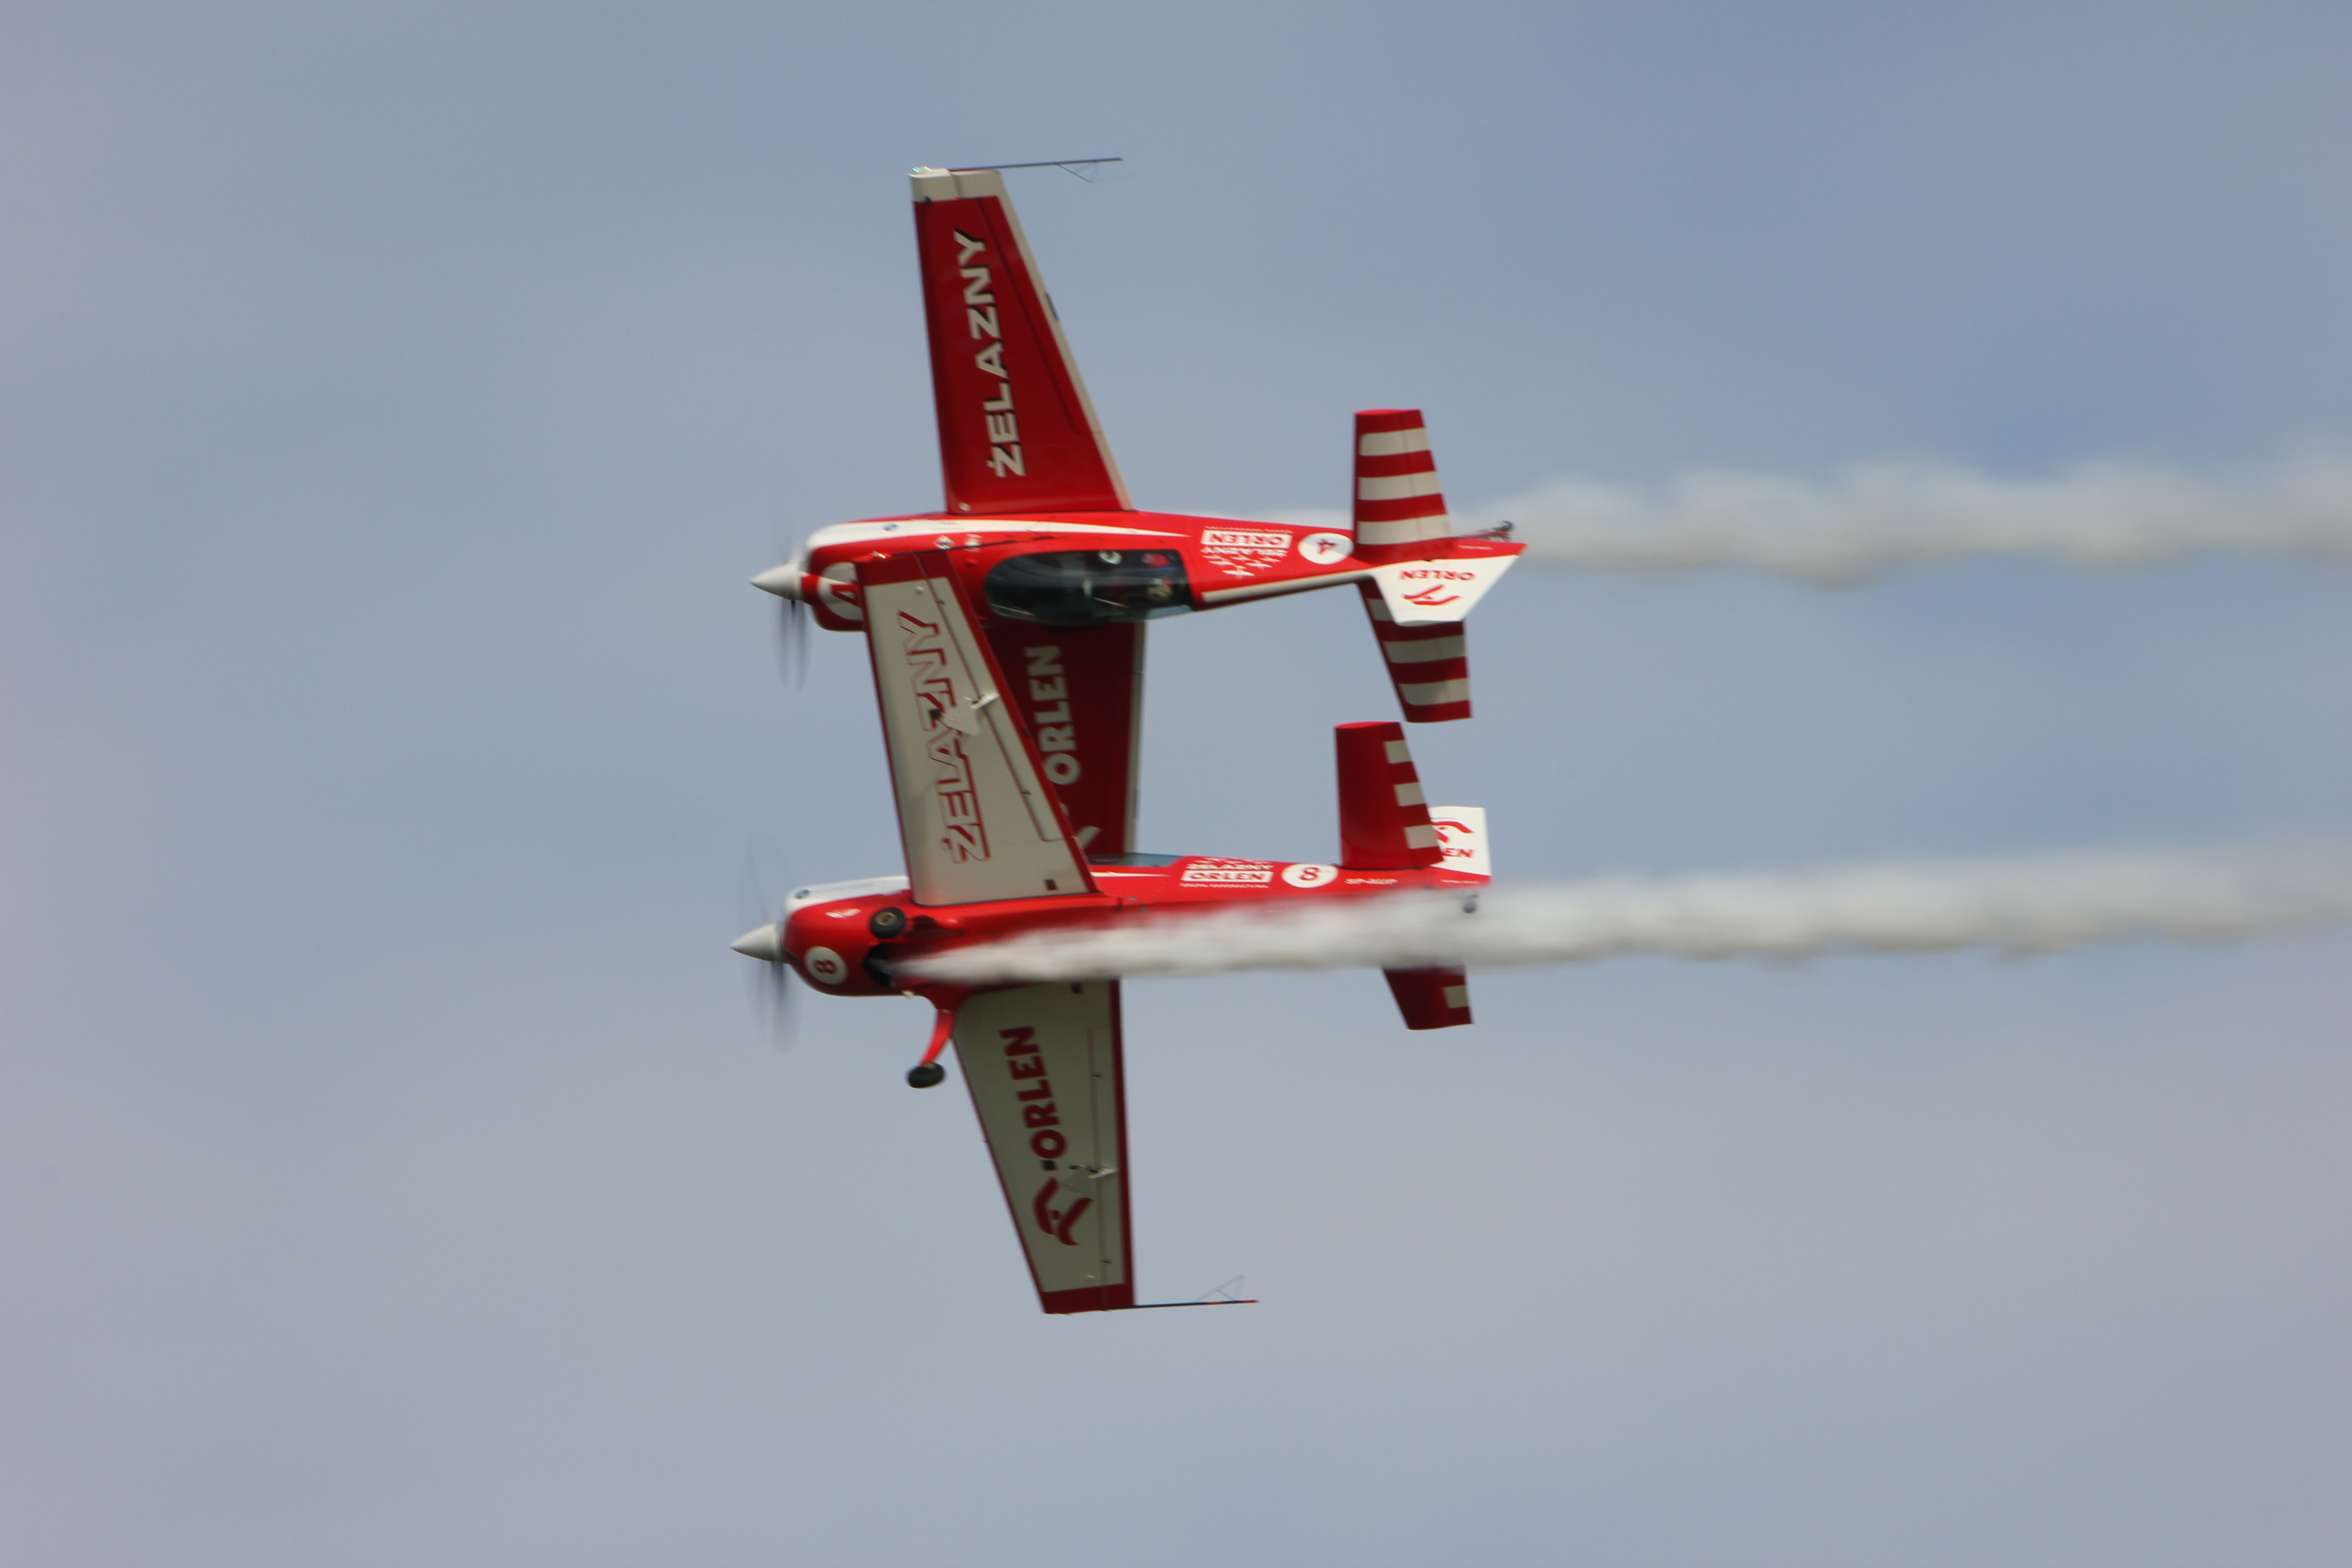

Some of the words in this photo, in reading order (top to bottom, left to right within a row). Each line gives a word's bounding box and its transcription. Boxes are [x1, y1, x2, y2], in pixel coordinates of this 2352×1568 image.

[954, 227, 1026, 478] ŻELAZNY
[1208, 532, 1284, 546] ORLEN
[1316, 539, 1338, 555] 4
[1399, 570, 1475, 581] ORLEN
[1024, 645, 1082, 785] ORLEN
[897, 610, 991, 864] ŻELAZNY
[1189, 872, 1264, 881] ORLEN
[1298, 867, 1321, 882] 8
[813, 959, 837, 975] 8
[999, 1026, 1068, 1159] ORLEN
